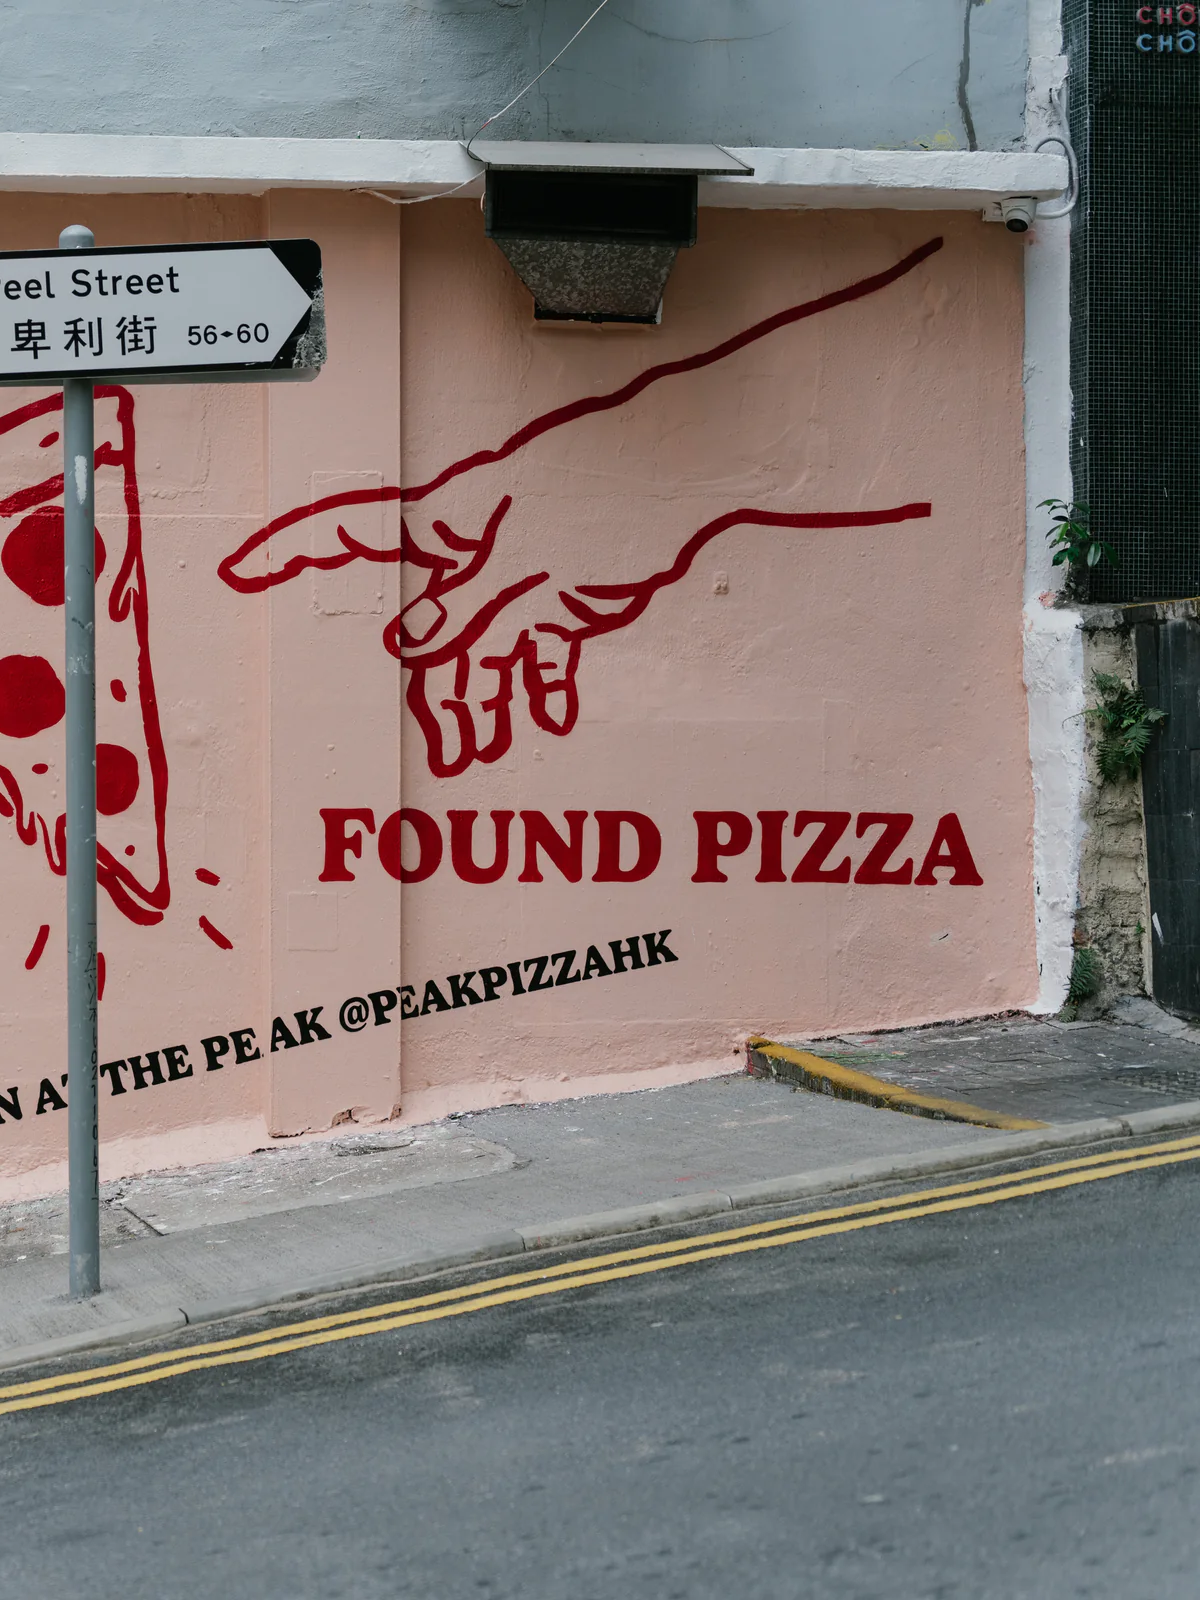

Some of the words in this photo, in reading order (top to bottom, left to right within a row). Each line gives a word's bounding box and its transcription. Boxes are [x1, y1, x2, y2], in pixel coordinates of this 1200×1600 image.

[1136, 3, 1200, 25] CHÔ
[1136, 29, 1200, 52] CHÔ
[70, 266, 180, 297] Street
[10, 314, 157, 359] 卑利街
[318, 807, 662, 885] FOUND
[691, 810, 984, 887] PIZZA
[35, 1073, 69, 1115] A
[99, 1044, 194, 1097] THE
[200, 1006, 332, 1072] PEAK
[339, 929, 679, 1033] @PEAKPIZZAHK
